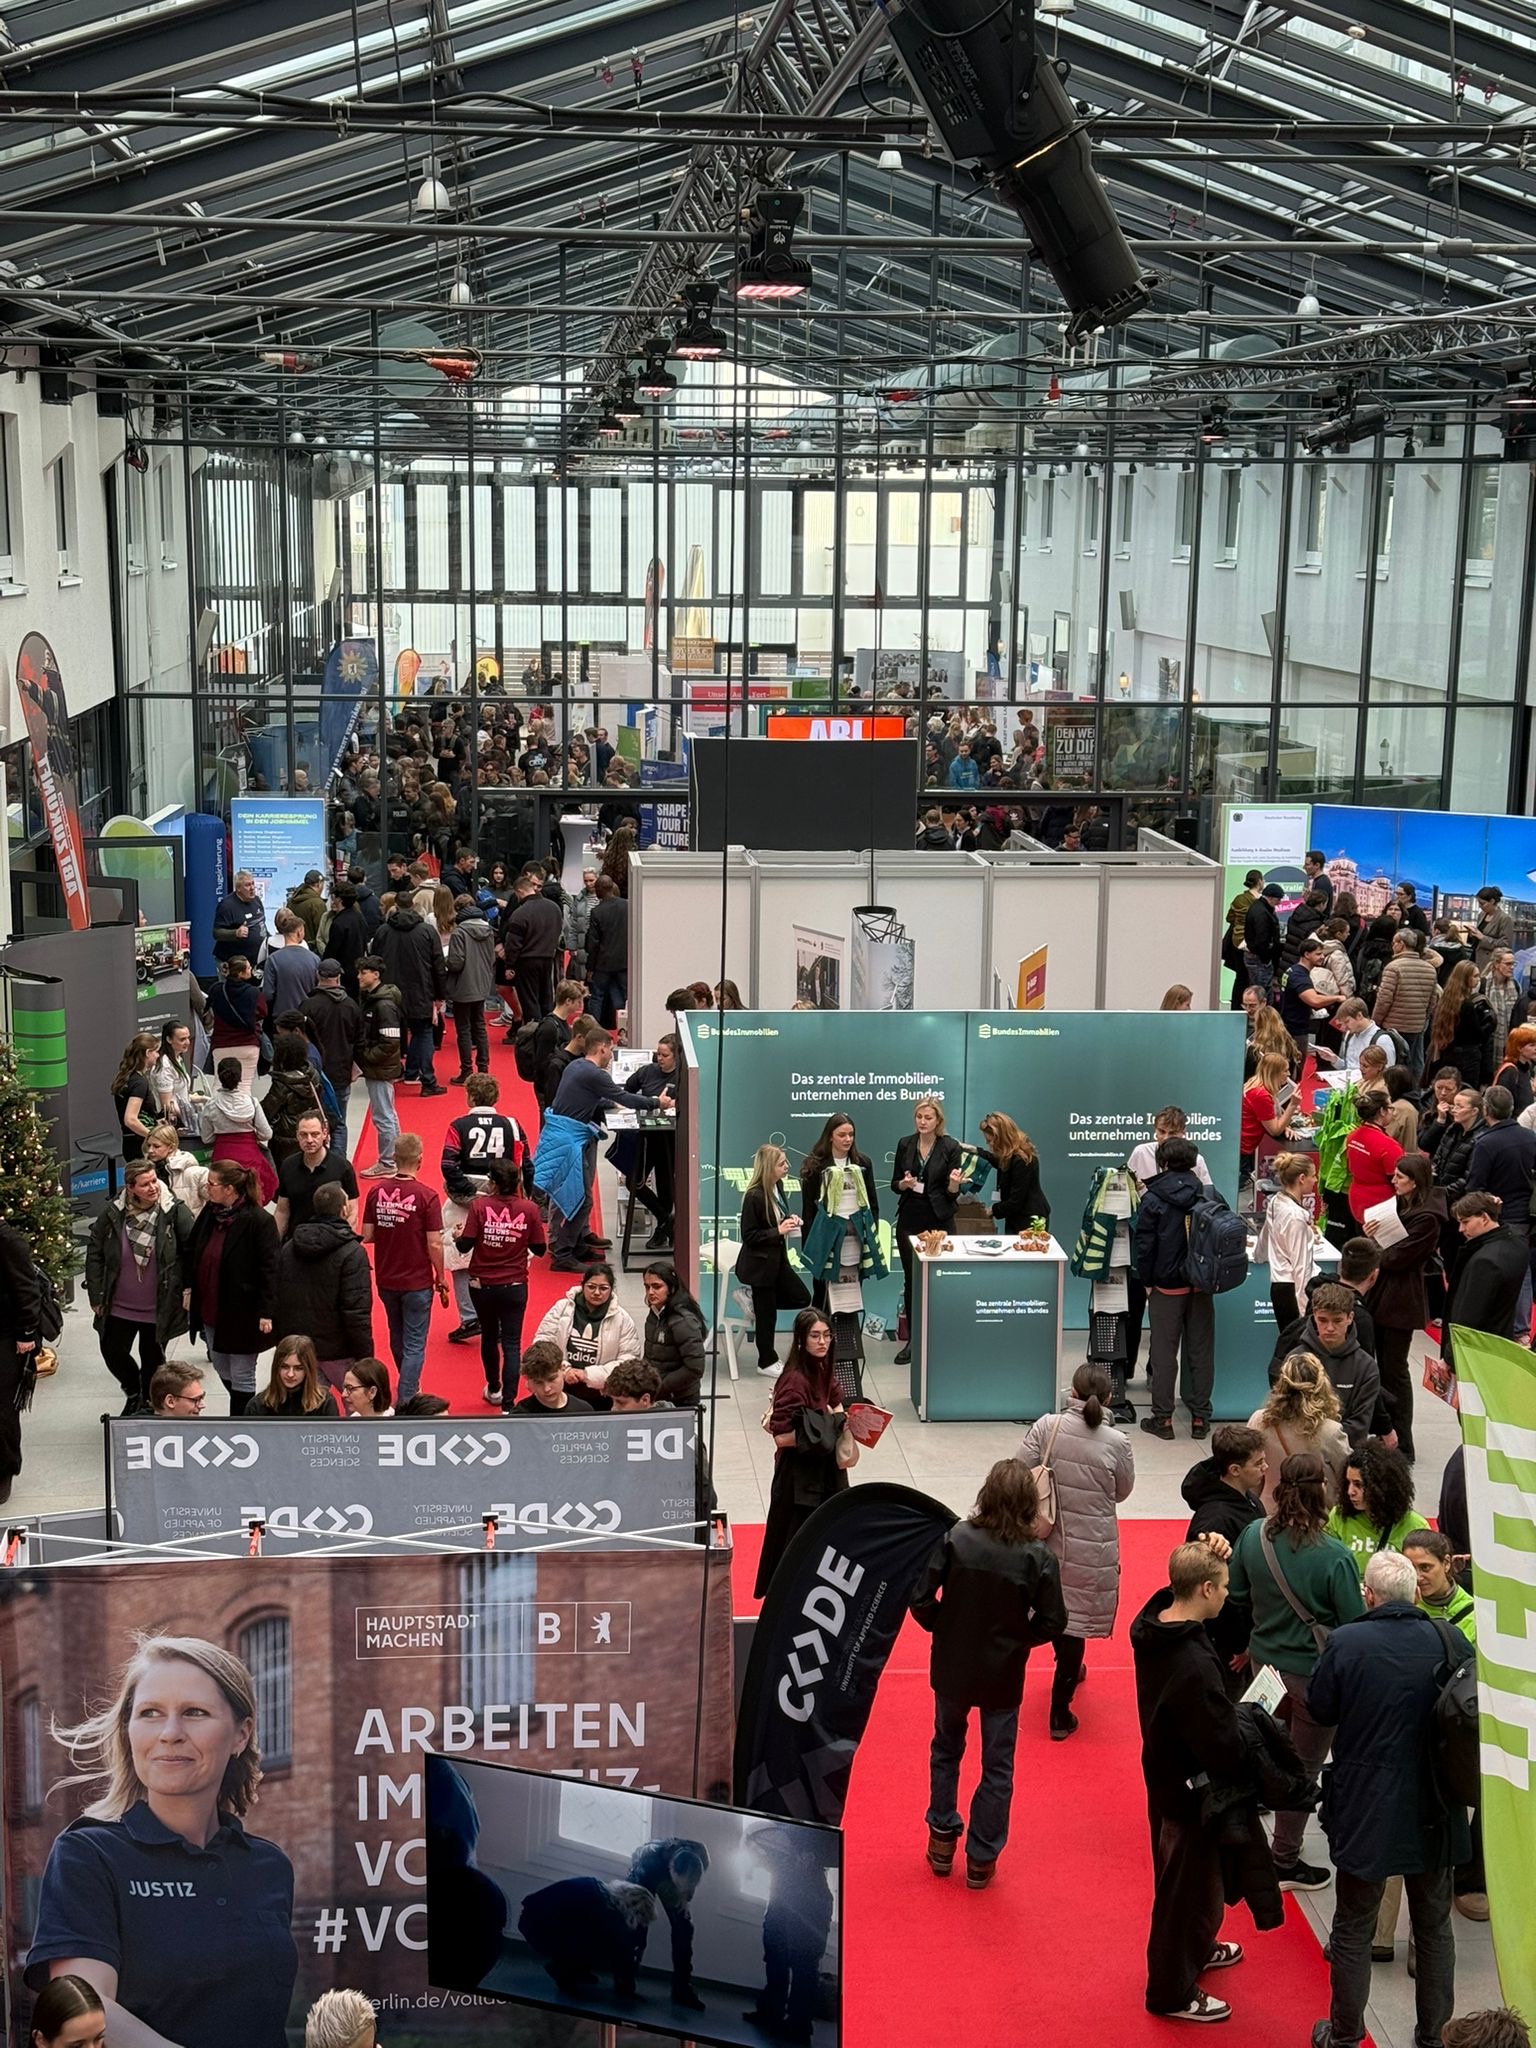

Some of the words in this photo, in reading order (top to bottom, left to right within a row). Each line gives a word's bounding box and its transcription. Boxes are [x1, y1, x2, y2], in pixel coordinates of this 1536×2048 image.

[1056, 727, 1076, 739] DEN
[1078, 727, 1095, 739] WE
[1056, 740, 1074, 754] ZU
[656, 803, 687, 818] SHAPE
[656, 817, 681, 832] YOUR
[656, 831, 689, 847] FUTURE
[992, 1028, 1060, 1036] BundesImmobilien
[791, 1073, 814, 1085] Das
[817, 1072, 866, 1085] zentrale
[868, 1072, 945, 1085] Immobilien-
[791, 1088, 873, 1101] unternehmen
[876, 1088, 898, 1101] des
[1069, 1113, 1093, 1125] Das
[1095, 1113, 1144, 1125] zentrale
[1069, 1129, 1150, 1141] unternehmen
[1184, 1128, 1222, 1141] undes
[468, 1126, 505, 1159] 24
[366, 1614, 479, 1632] HAUPTSTADT
[538, 1612, 562, 1645] B
[366, 1632, 444, 1649] MACHEN
[840, 1653, 856, 1692] UNIVERSITY
[858, 1613, 874, 1643] APPLIED
[870, 1581, 888, 1614] SCIENCES
[354, 1701, 646, 1756] ARBEITEN
[358, 1773, 421, 1821] IM
[129, 1880, 197, 1897] JUSTIZ
